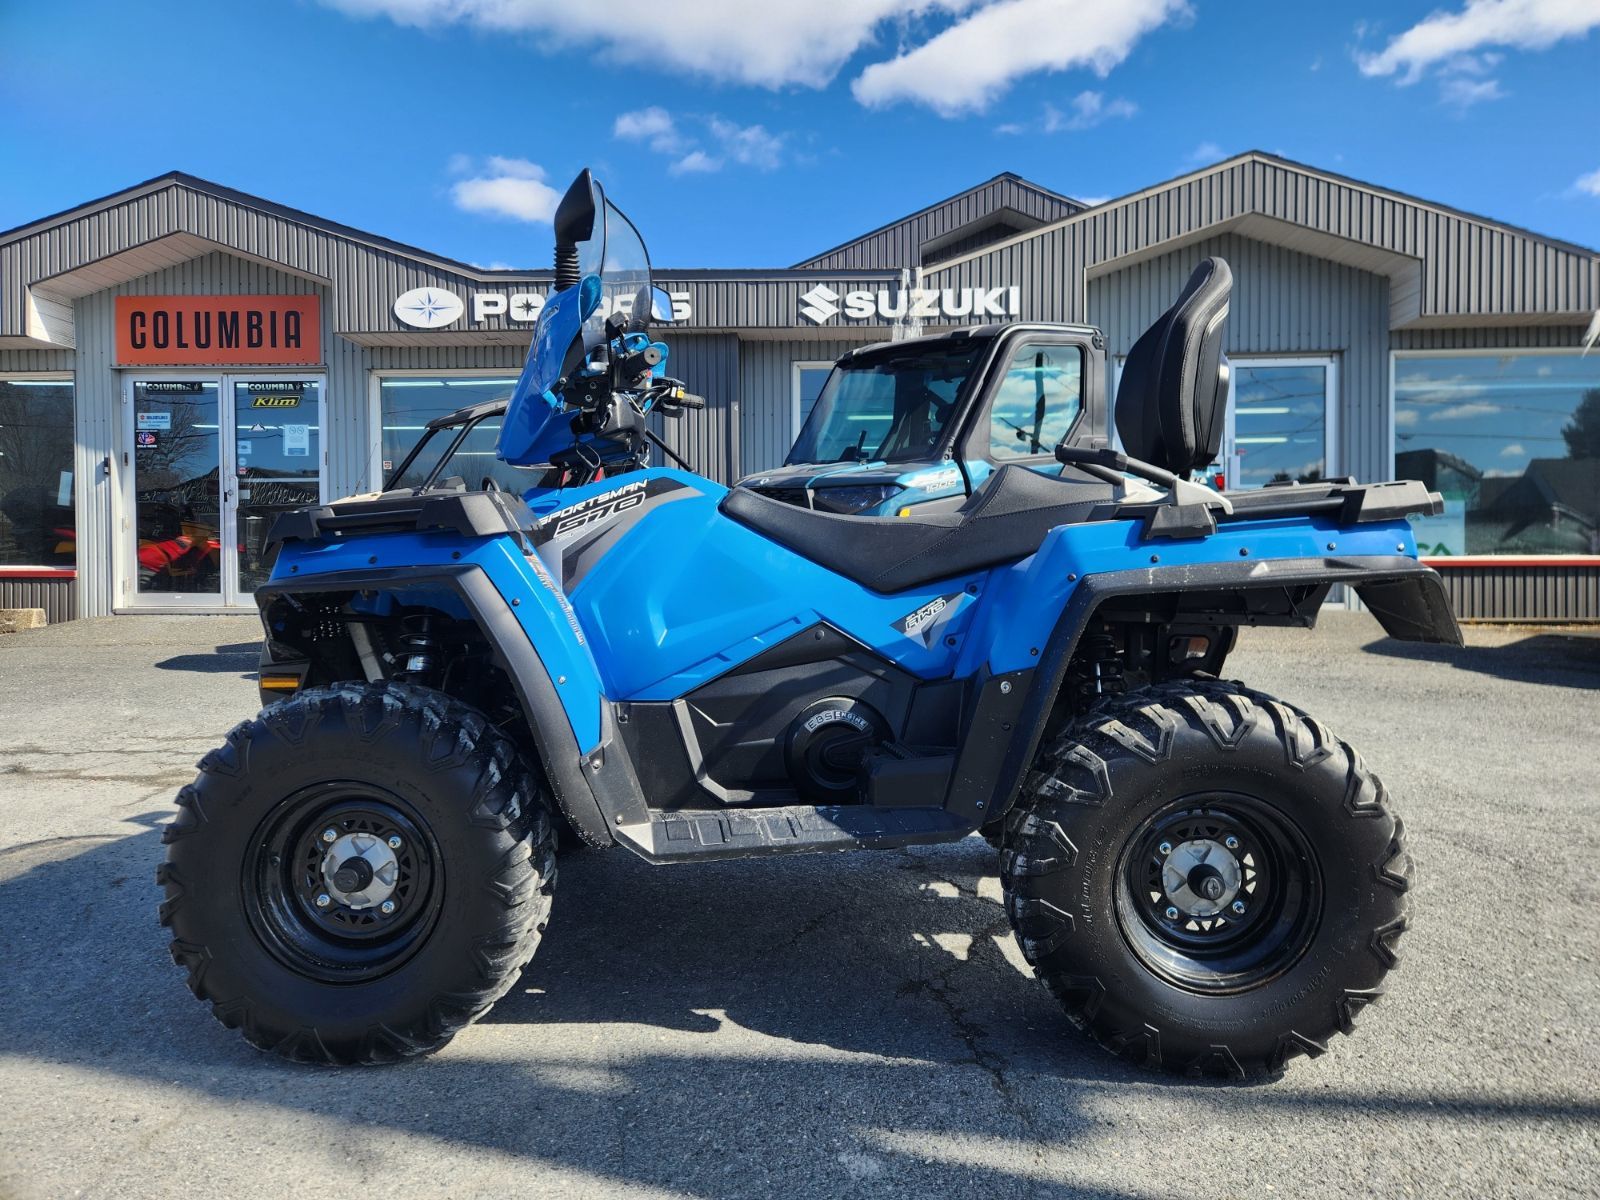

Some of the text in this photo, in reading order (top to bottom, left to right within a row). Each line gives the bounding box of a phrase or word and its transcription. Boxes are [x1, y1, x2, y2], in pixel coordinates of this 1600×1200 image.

[843, 285, 1020, 319] SUZUKI
[130, 310, 301, 349] COLUMBIA
[248, 383, 295, 391] COLUMBIA
[538, 479, 648, 525] SPORTSMAN
[553, 491, 646, 538] 570
[905, 599, 947, 631] AWD
[807, 712, 833, 730] EBS
[835, 711, 867, 727] ENGINE
